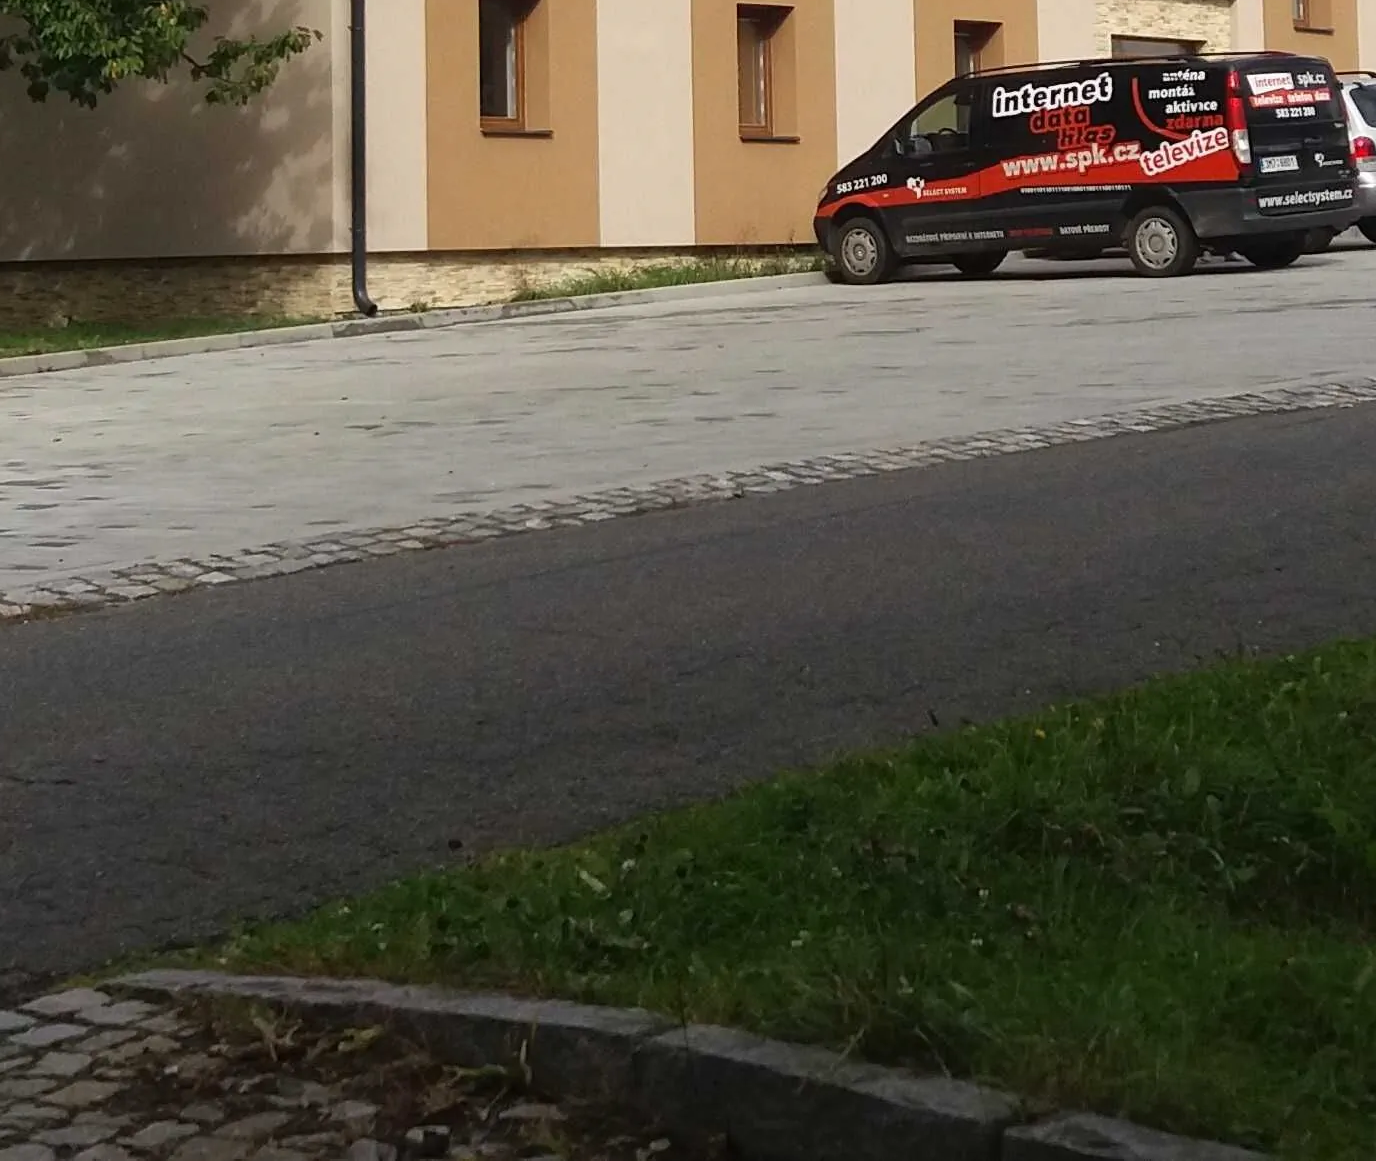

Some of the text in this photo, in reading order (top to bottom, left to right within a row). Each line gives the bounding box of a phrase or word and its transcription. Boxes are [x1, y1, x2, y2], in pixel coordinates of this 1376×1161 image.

[1254, 70, 1326, 89] internet spk.cz
[993, 72, 1112, 117] internet
[1030, 106, 1091, 134] data
[1165, 113, 1224, 130] zdarma
[1290, 107, 1303, 117] 221
[1057, 124, 1116, 150] hlas
[1002, 141, 1141, 177] www.spk.cz
[1140, 127, 1229, 176] televize
[836, 174, 888, 195] 583 221 200
[1258, 189, 1353, 208] www.selectsystem.cz
